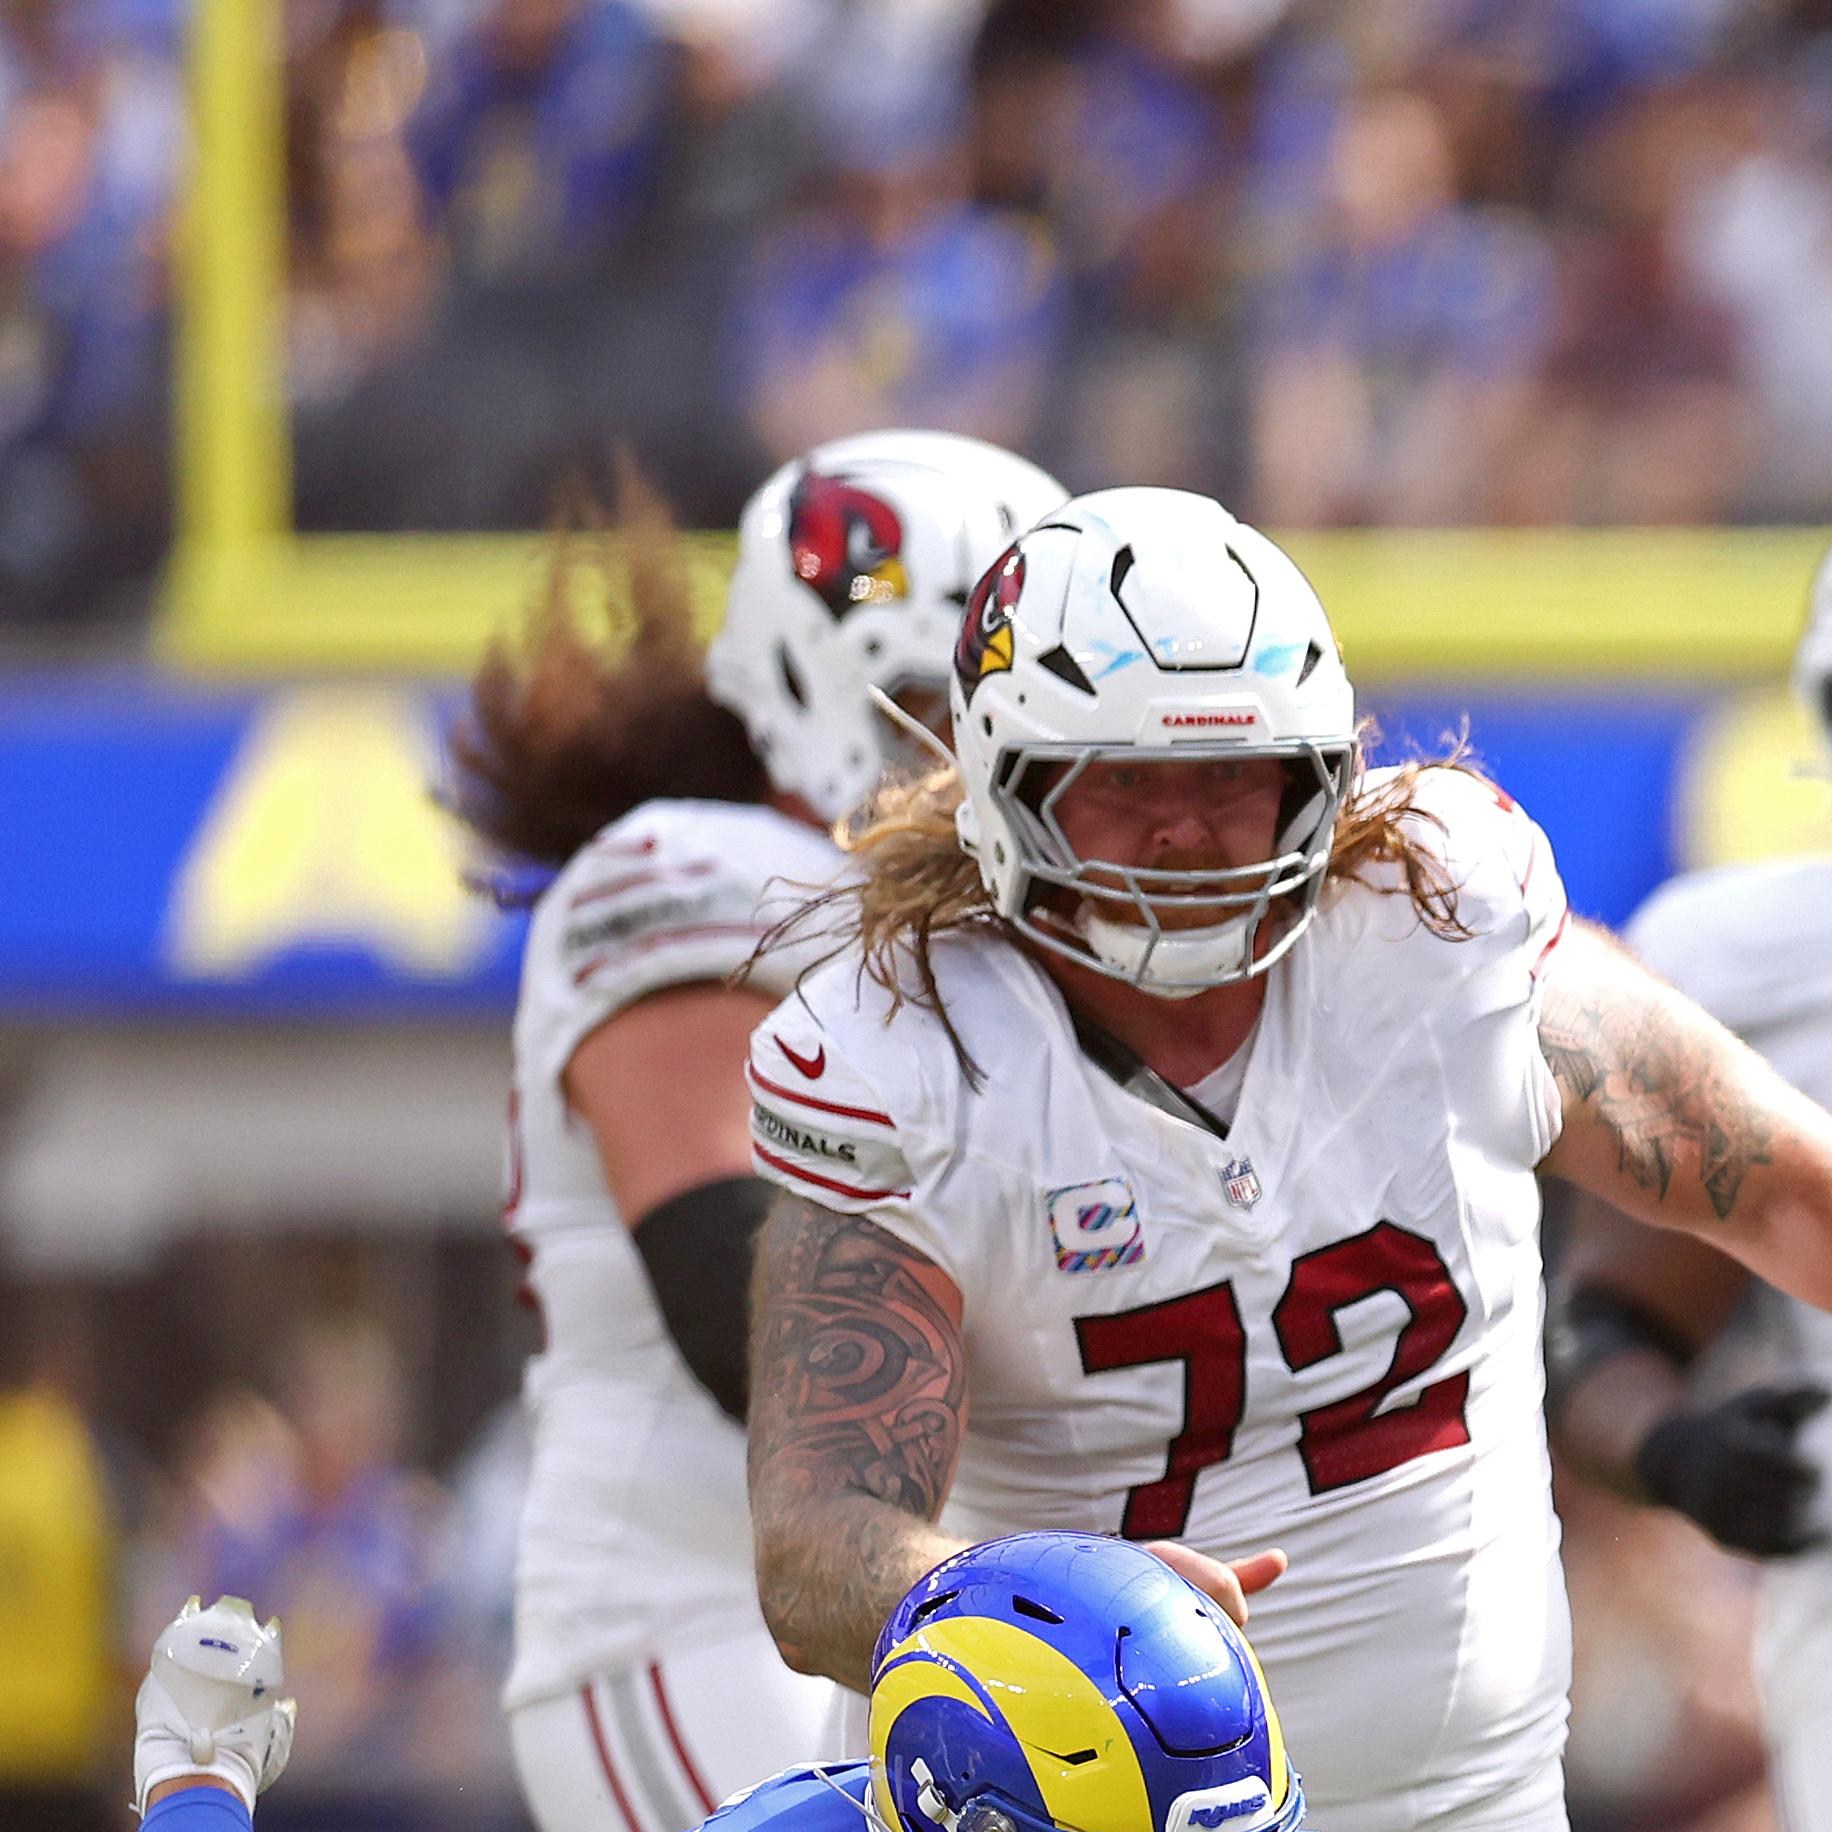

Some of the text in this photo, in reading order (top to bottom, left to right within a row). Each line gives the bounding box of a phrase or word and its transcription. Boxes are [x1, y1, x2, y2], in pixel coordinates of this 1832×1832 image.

[1161, 714, 1256, 727] CARDINALS
[755, 1106, 857, 1162] DINALS
[1075, 1220, 1473, 1541] 72
[1187, 1793, 1267, 1829] RAMS
